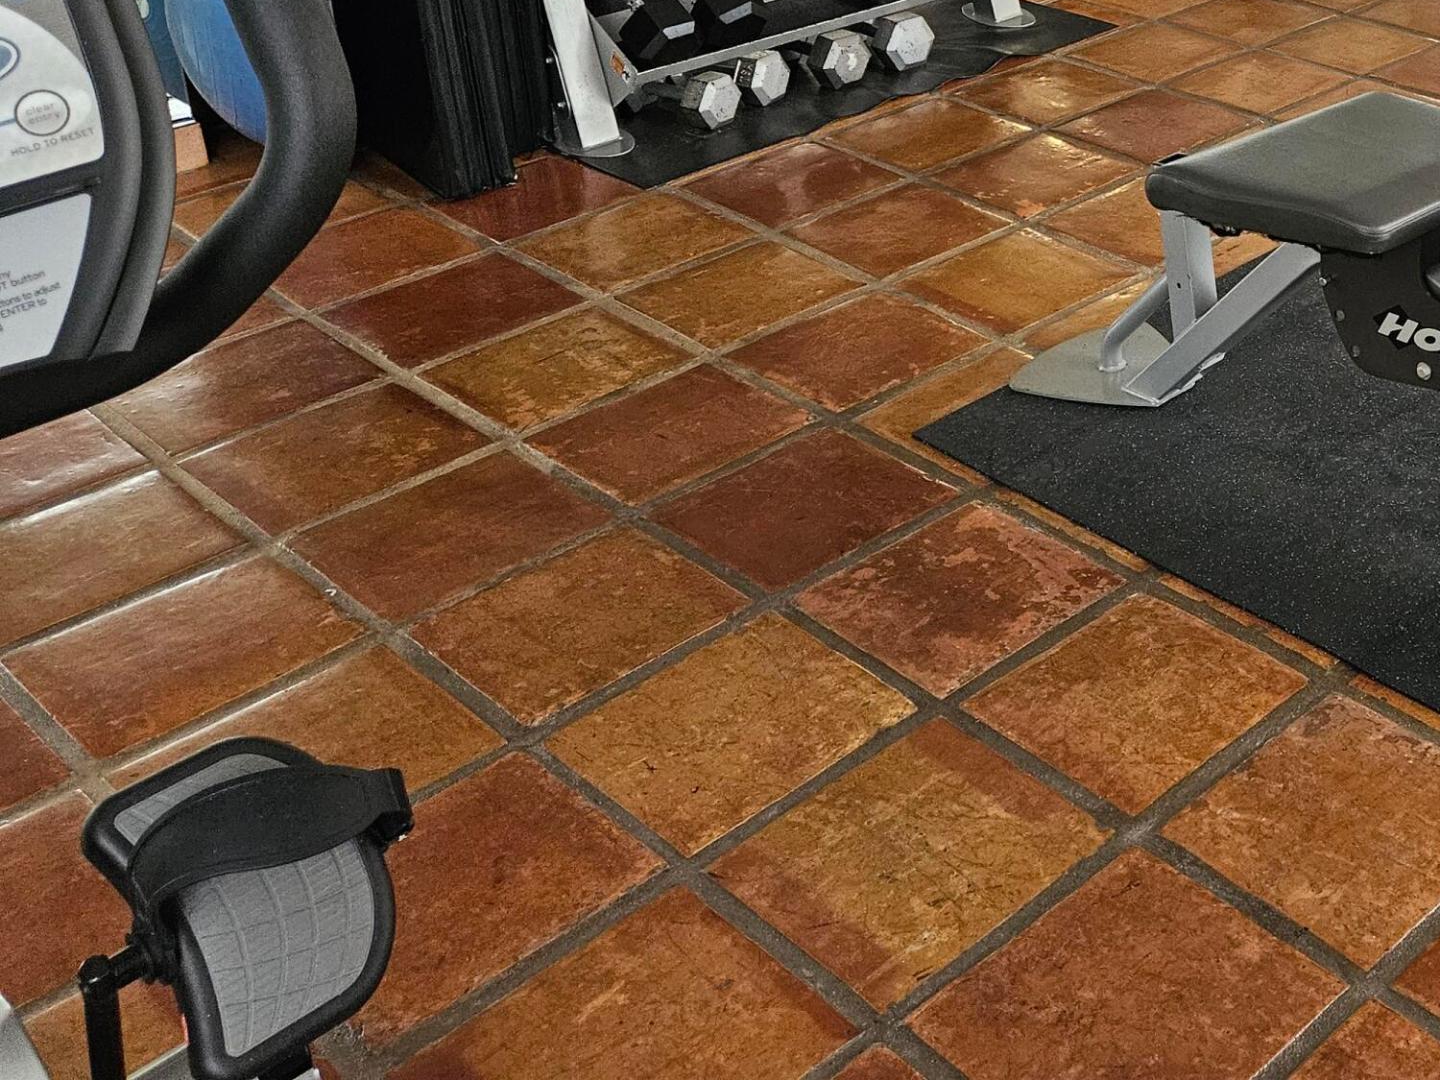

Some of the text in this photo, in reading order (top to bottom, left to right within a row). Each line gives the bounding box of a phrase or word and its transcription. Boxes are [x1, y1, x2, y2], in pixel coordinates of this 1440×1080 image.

[11, 127, 95, 157] HOLD TO RESET
